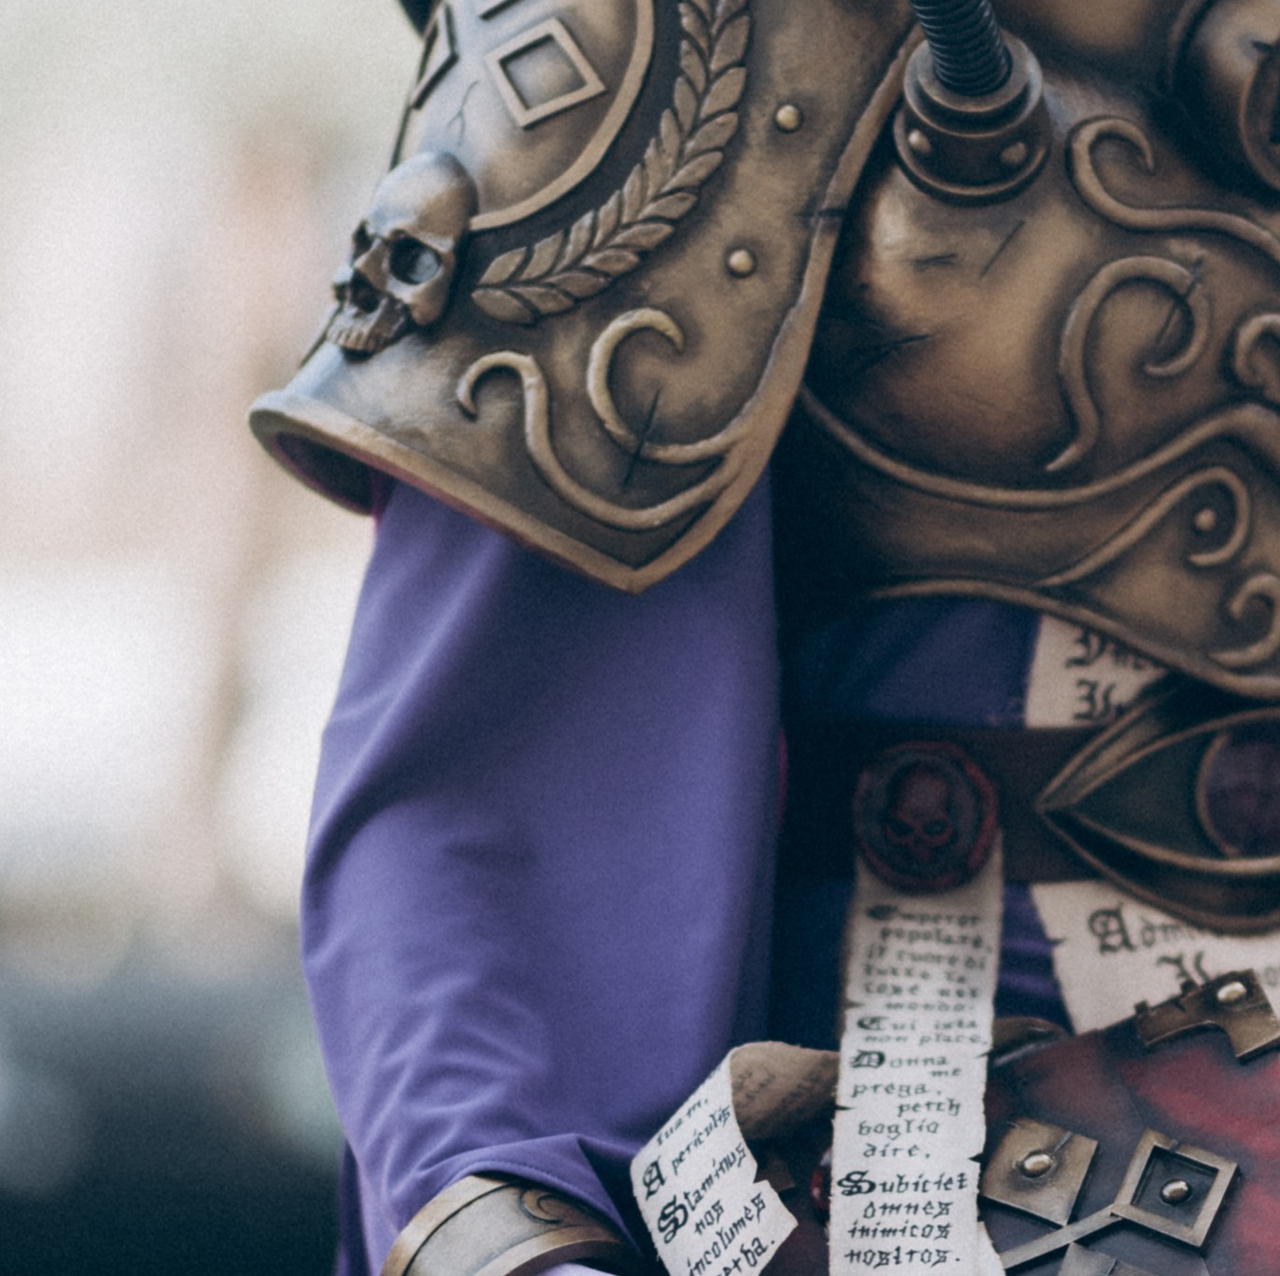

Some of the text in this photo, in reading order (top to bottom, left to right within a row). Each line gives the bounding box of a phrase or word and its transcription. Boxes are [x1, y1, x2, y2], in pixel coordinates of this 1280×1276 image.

[694, 1200, 724, 1236] nos
[863, 1201, 953, 1220] omnes
[847, 1220, 951, 1241] inimicos
